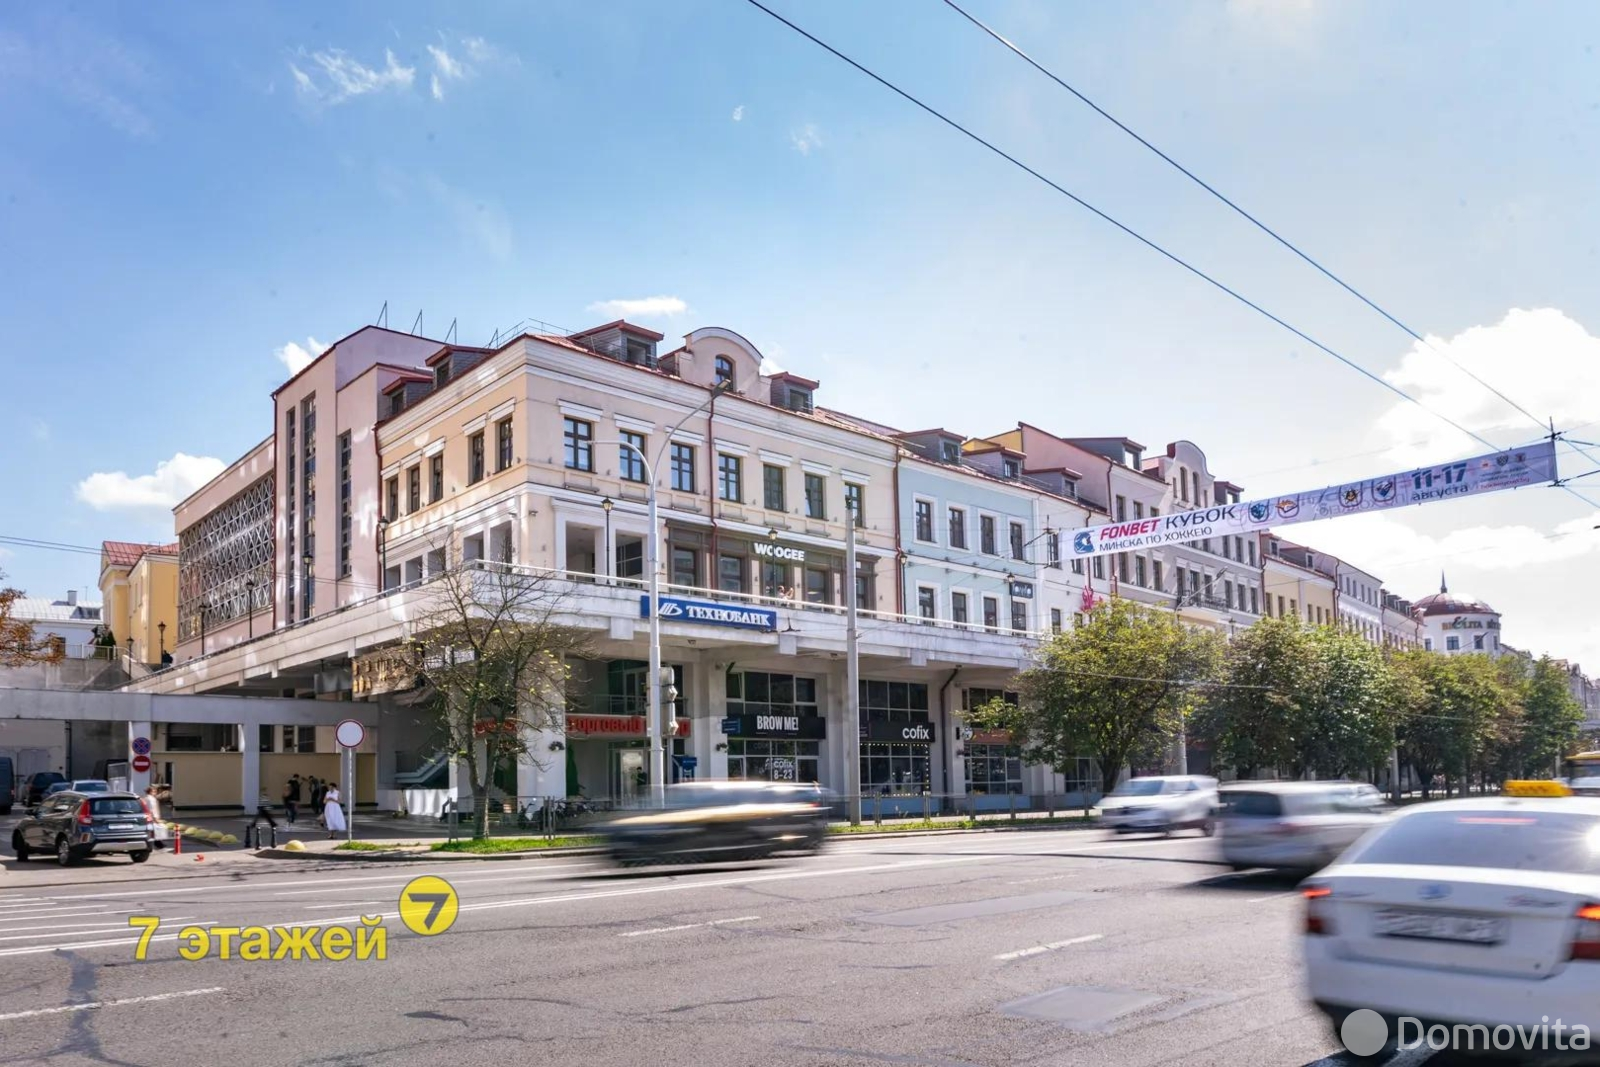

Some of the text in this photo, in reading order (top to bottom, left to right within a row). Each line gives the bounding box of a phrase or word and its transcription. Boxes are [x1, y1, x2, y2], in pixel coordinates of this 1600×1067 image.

[1411, 462, 1467, 489] 11-17
[1412, 483, 1469, 501] августа
[1100, 506, 1236, 541] FONBET КУБОК
[1100, 526, 1212, 552] МИНСКА ПО ХОККЕЮ
[754, 542, 805, 561] WOOGEE
[686, 605, 770, 626] ТЕХНОБАНК
[757, 715, 799, 730] BROW ME!
[902, 725, 930, 740] cofix
[773, 759, 794, 769] cofix
[773, 769, 793, 780] 8-23
